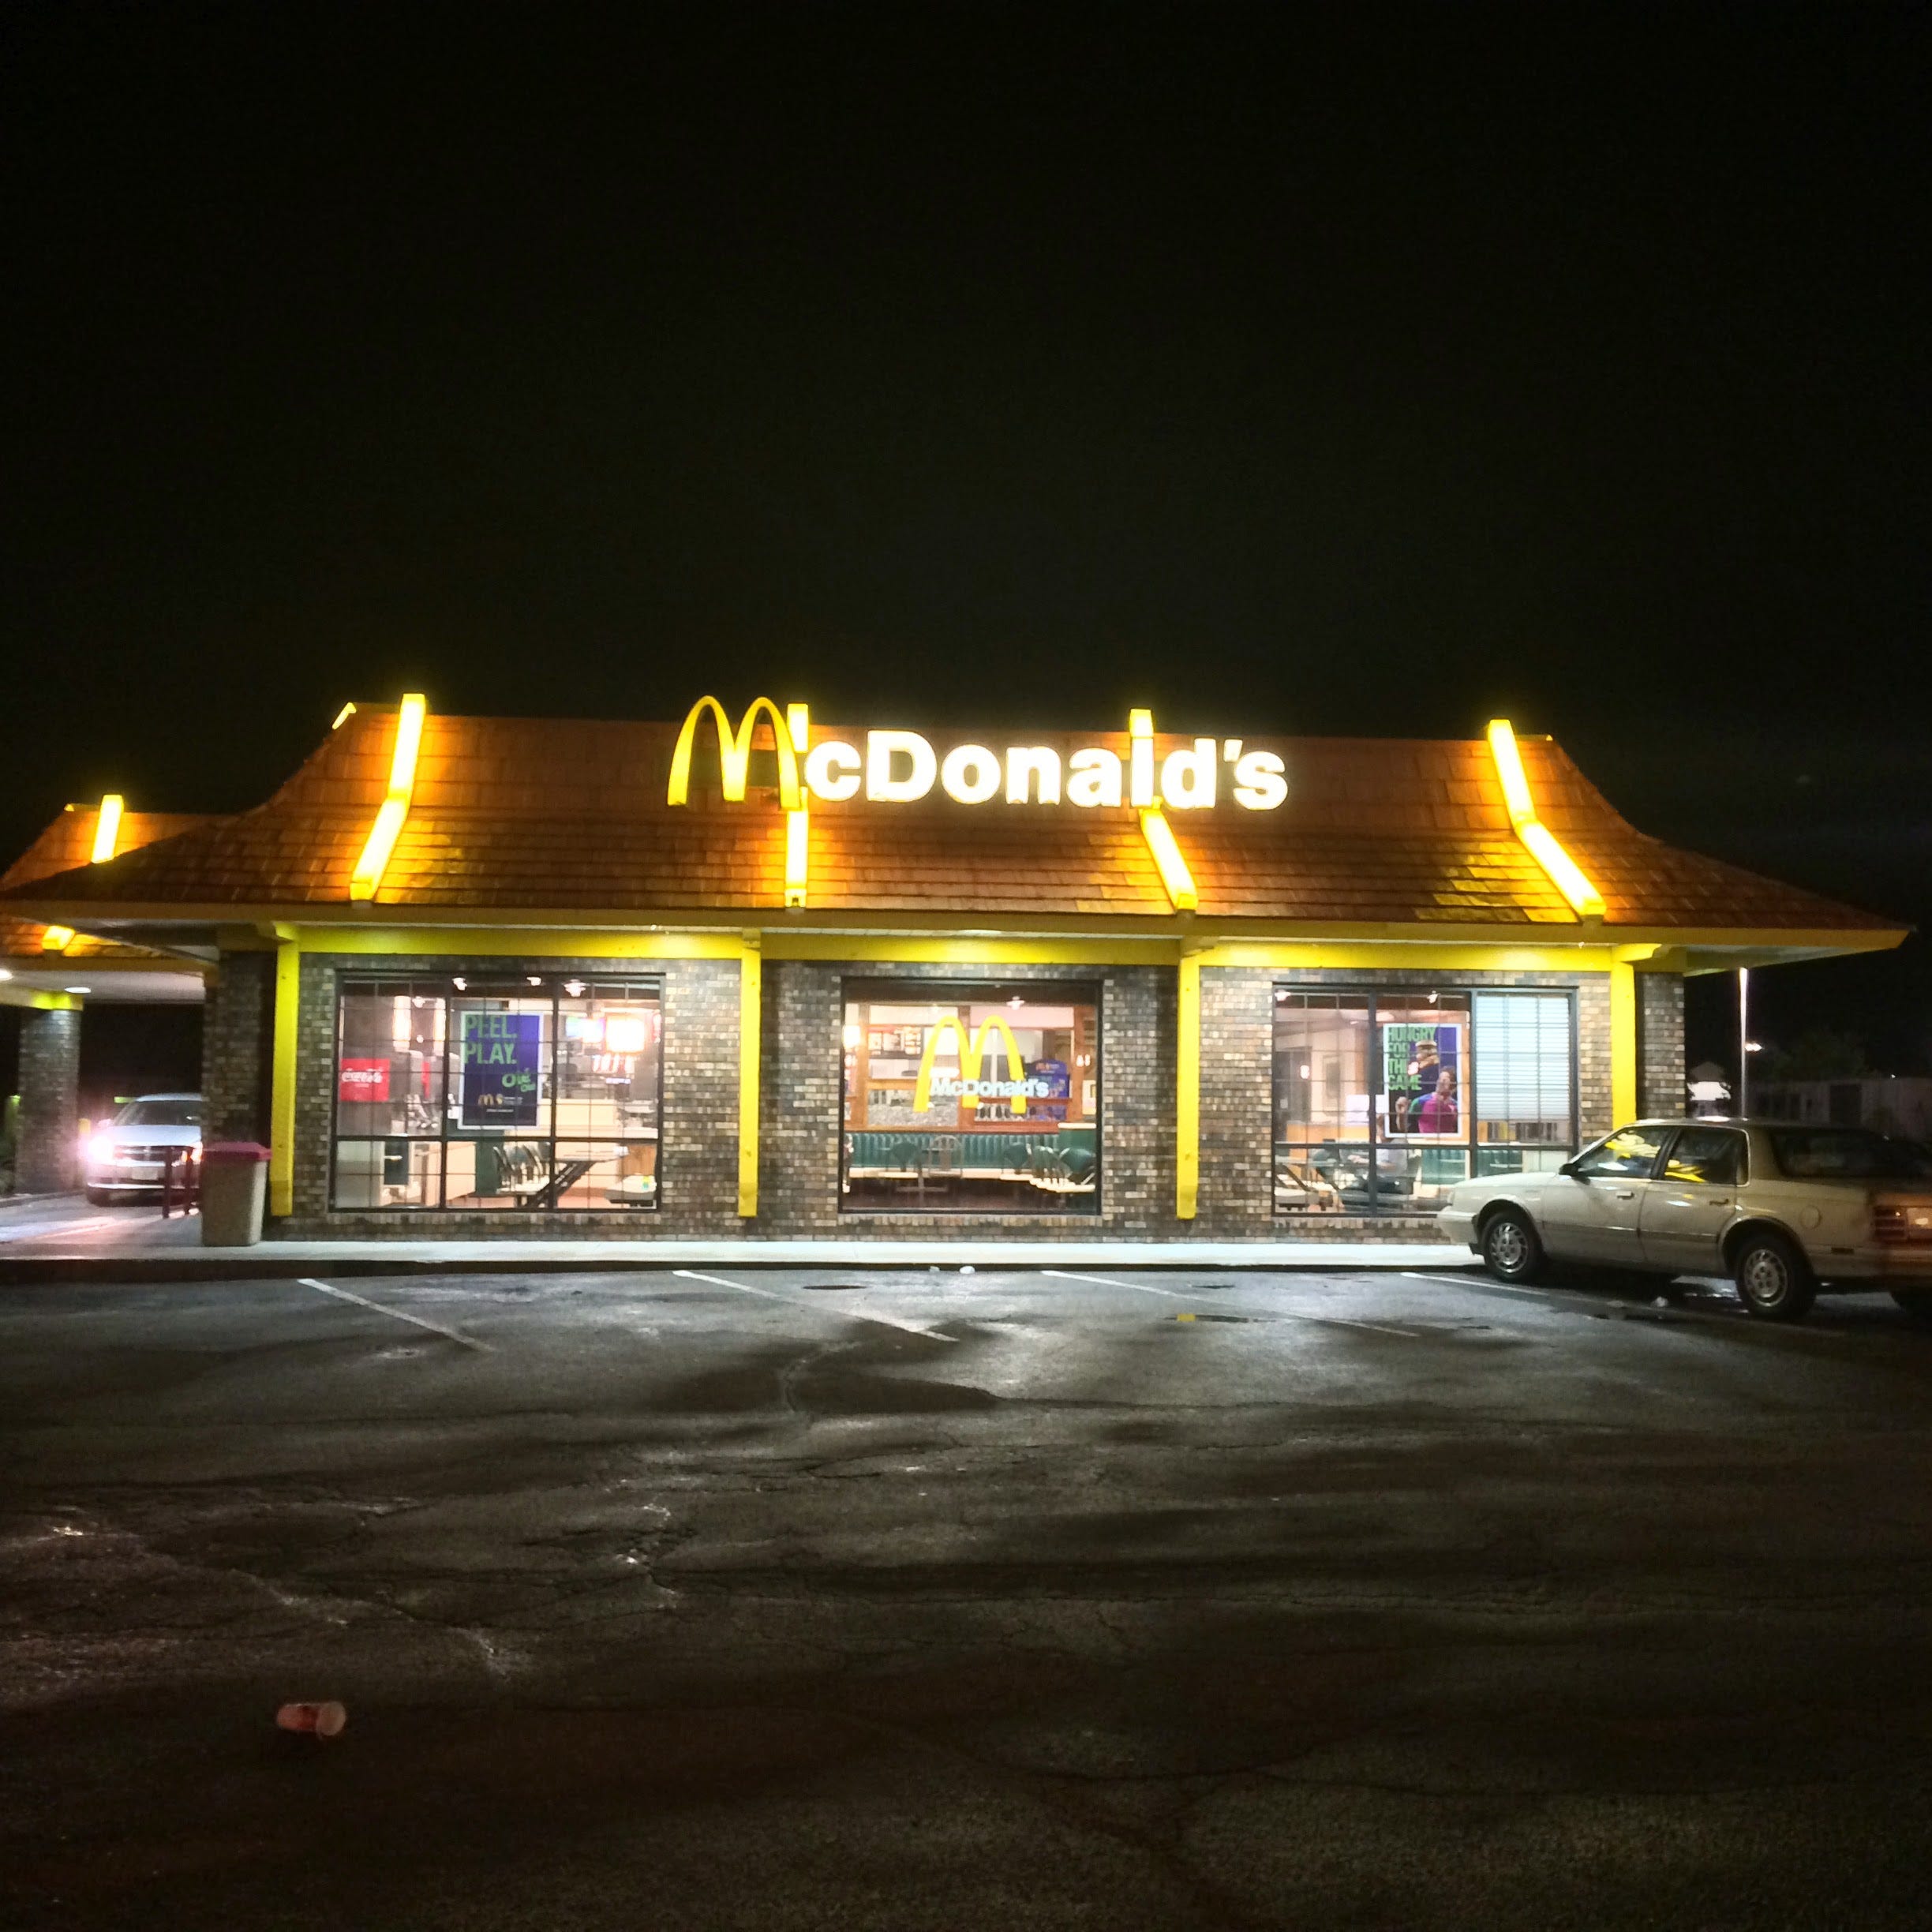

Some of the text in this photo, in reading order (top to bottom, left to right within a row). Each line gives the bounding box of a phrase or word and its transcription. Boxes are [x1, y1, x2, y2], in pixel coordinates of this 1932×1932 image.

[667, 695, 1288, 811] McDonald's
[466, 1015, 518, 1038] PEEL.
[1389, 1028, 1436, 1041] HUNGRY
[465, 1043, 517, 1064] PLAY.
[1389, 1043, 1409, 1058] FOR
[930, 1076, 1049, 1098] McDonald's
[1389, 1074, 1422, 1091] GAME
